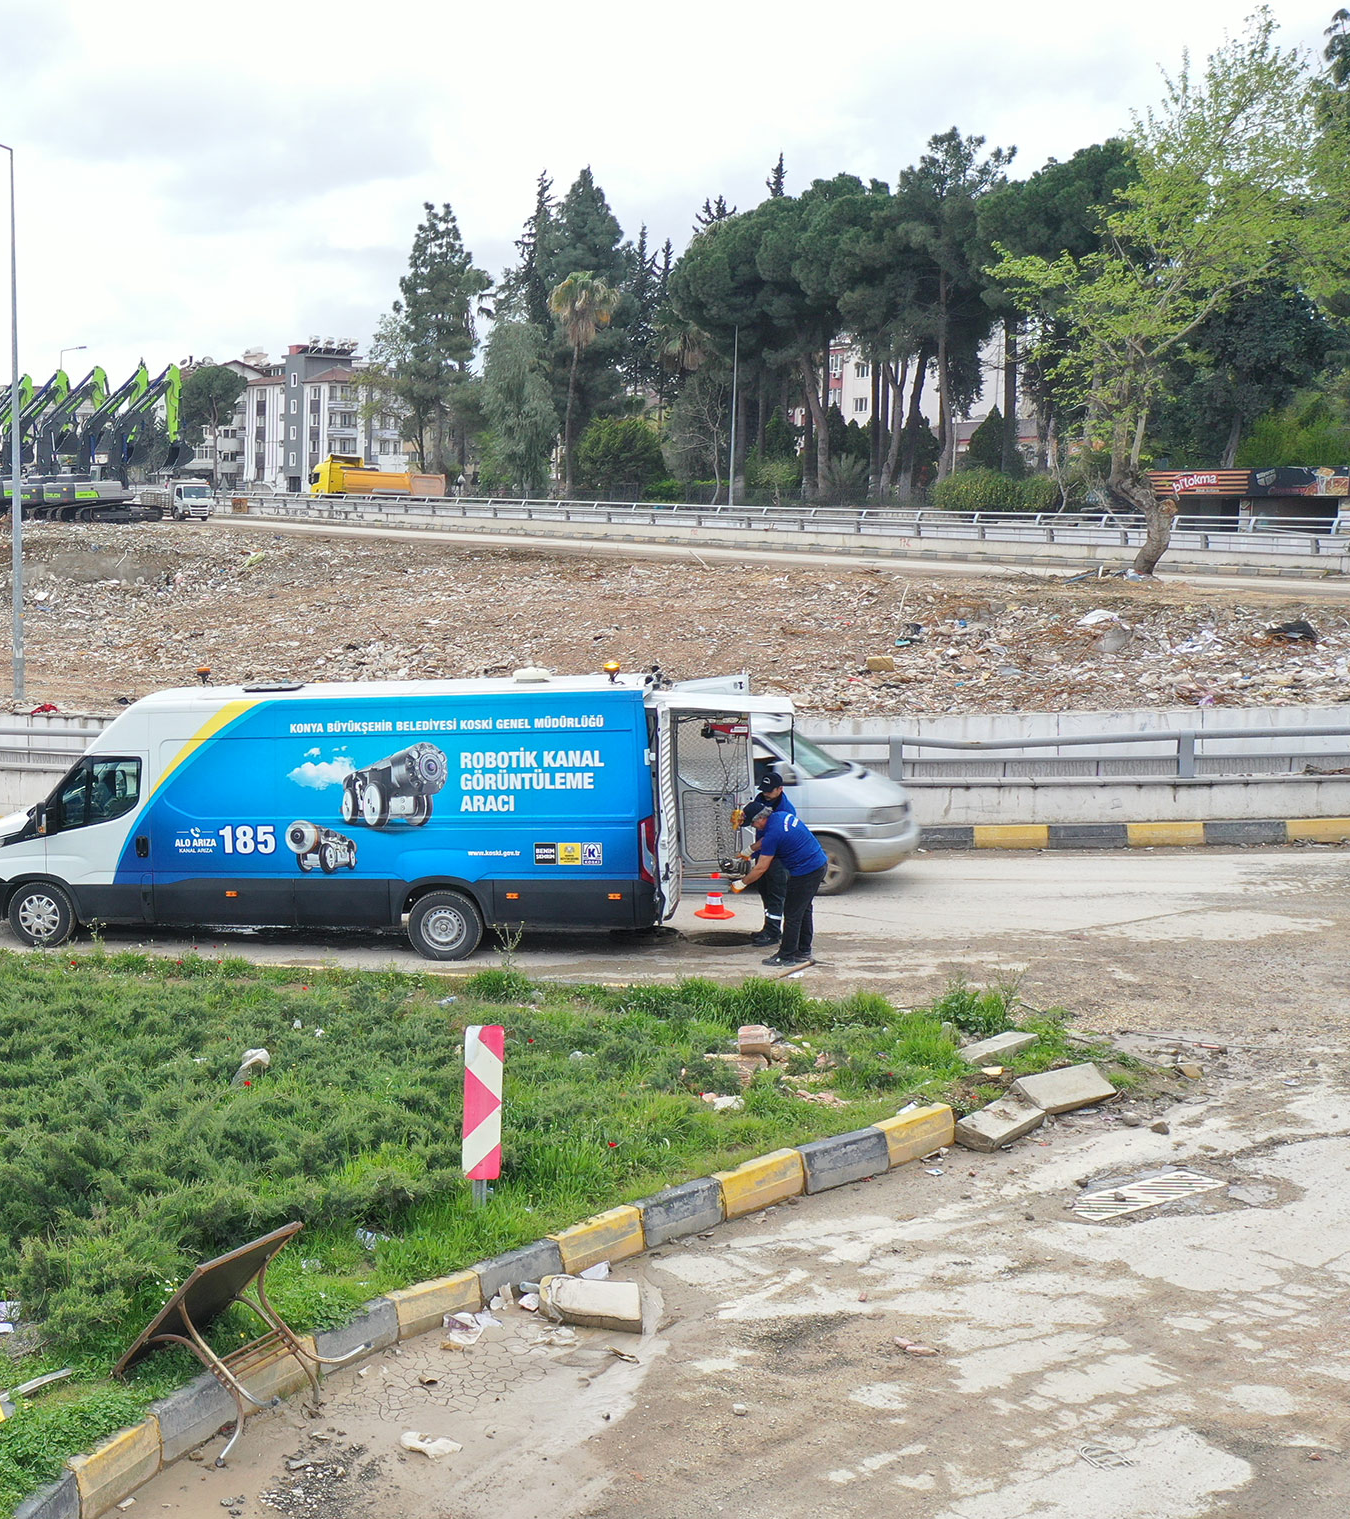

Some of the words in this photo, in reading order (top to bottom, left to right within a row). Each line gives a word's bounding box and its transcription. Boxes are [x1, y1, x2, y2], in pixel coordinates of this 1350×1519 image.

[290, 723, 324, 734] KONYA
[327, 720, 393, 735] BÜYÜKŞEHİR
[396, 718, 457, 732] BELEDİYESİ
[460, 717, 493, 730] KOSKİ
[496, 718, 531, 729] GENEL
[534, 714, 604, 728] MÜDÜRLÜĞÜ
[460, 747, 538, 768] ROBOTİK
[543, 750, 604, 767] KANAL
[460, 768, 594, 790] GÖRÜNTÜLEME
[460, 795, 515, 812] ARACI
[175, 838, 191, 847] ALO
[192, 838, 217, 847] ARIZA
[218, 825, 276, 854] 185
